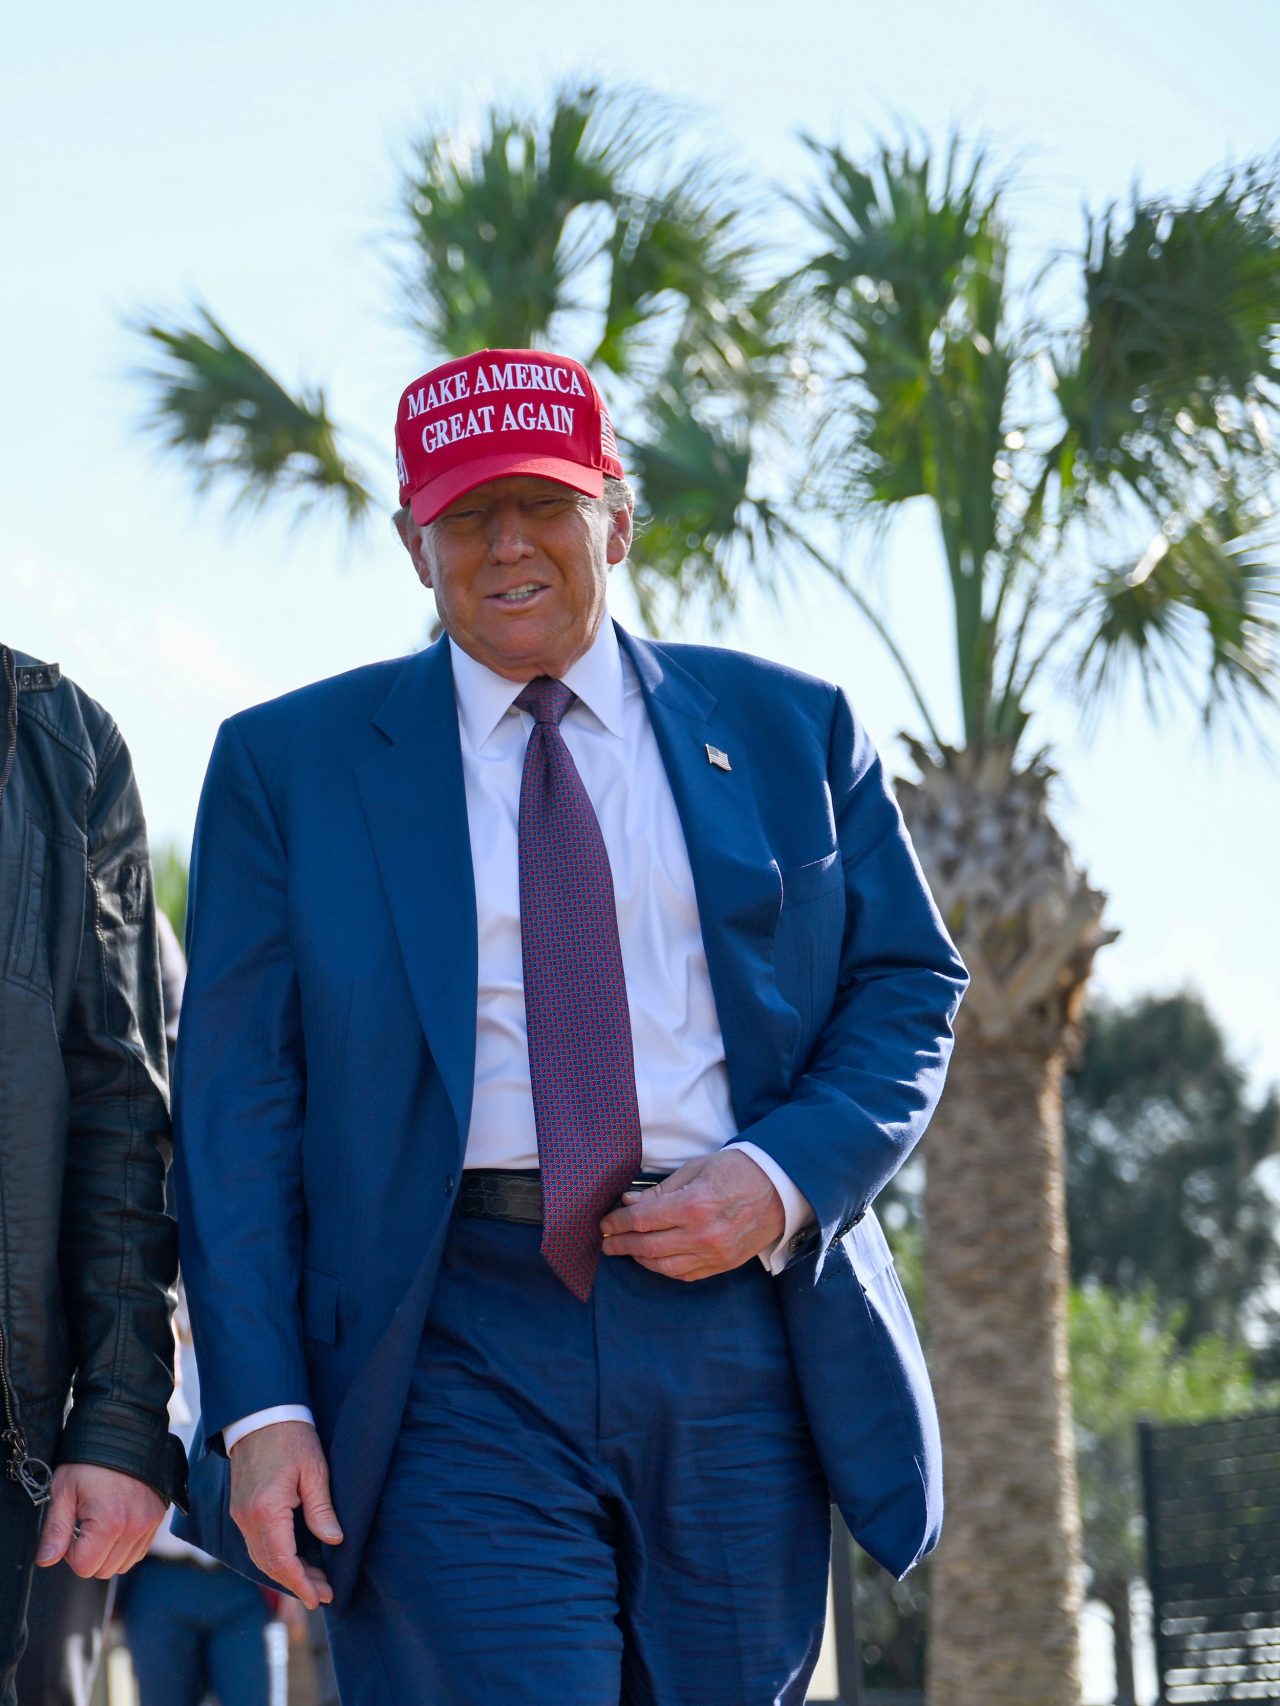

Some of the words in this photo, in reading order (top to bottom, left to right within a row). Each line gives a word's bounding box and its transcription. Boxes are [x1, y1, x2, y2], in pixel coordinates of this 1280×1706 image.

[407, 371, 471, 421] MAKE
[473, 363, 586, 397] AMERICA
[421, 405, 495, 454] GREAT
[500, 402, 575, 437] AGAIN
